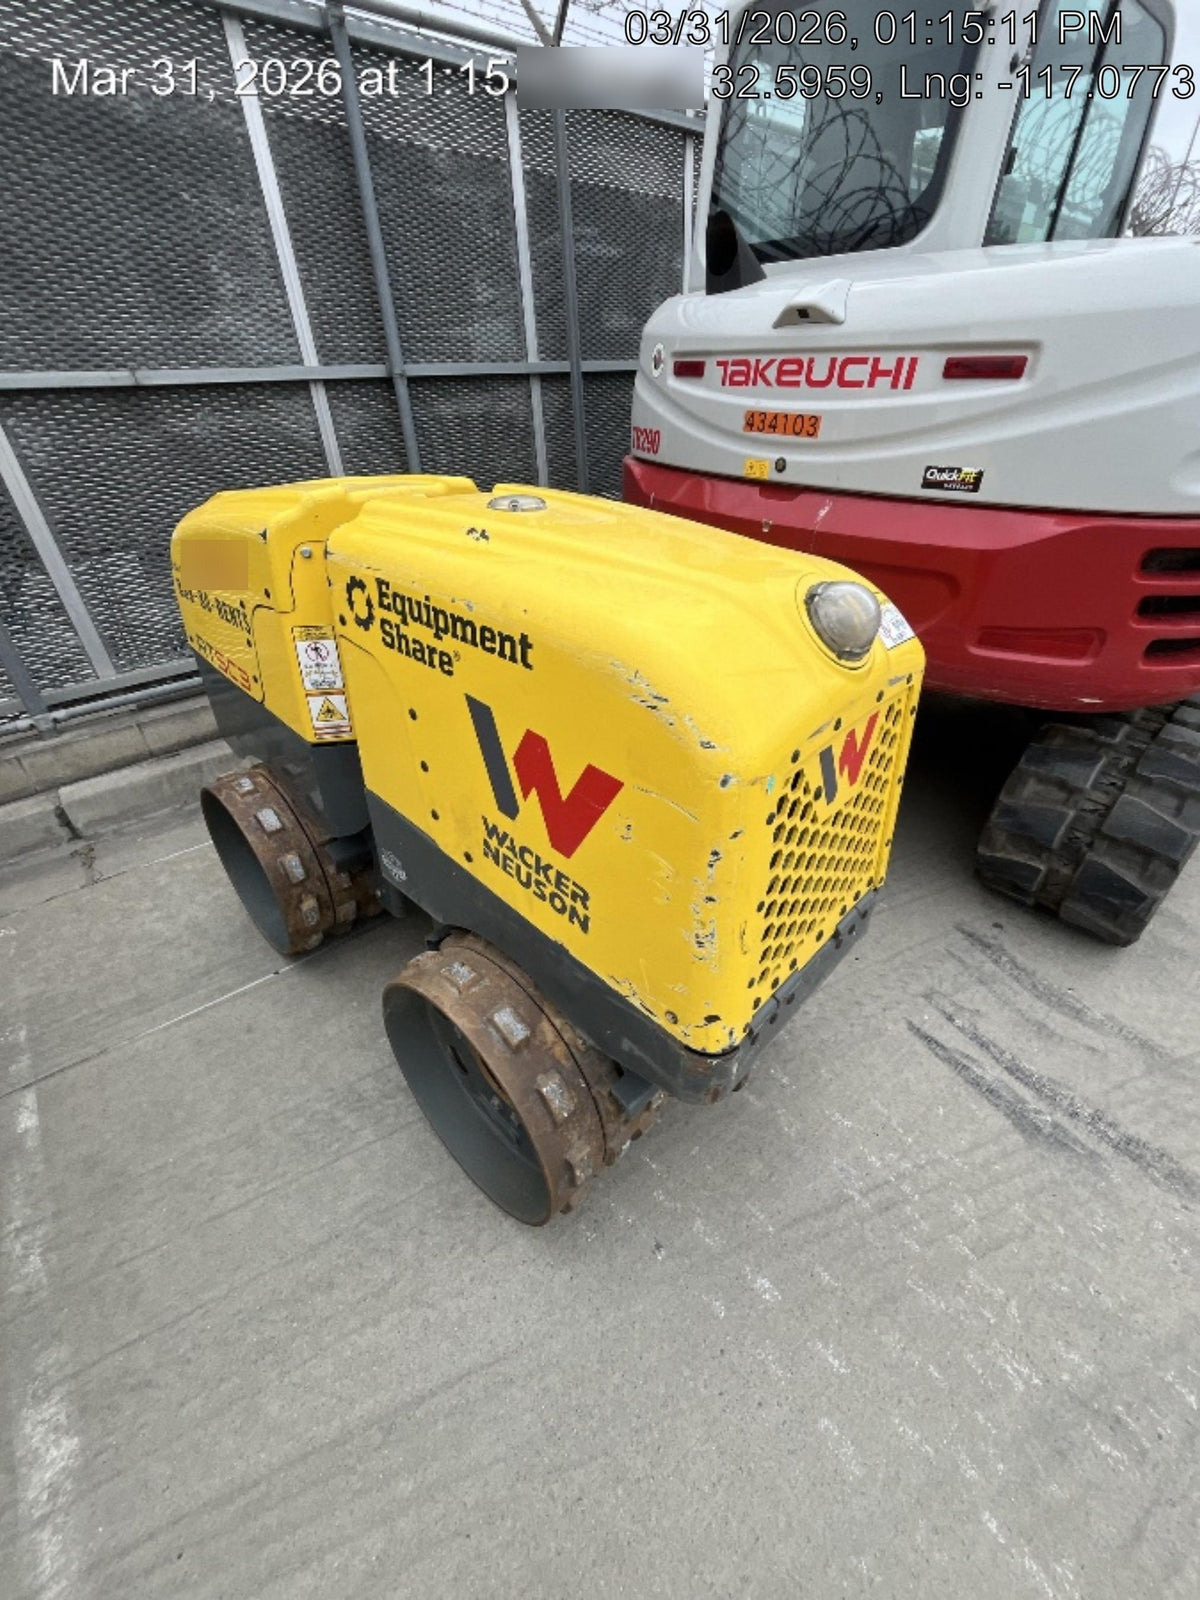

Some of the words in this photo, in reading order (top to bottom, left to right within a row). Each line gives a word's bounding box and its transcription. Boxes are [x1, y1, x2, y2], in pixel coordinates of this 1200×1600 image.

[745, 411, 819, 438] 434103
[375, 577, 533, 670] Equipment
[481, 814, 590, 910] WACKER
[483, 838, 590, 934] NEUSON
